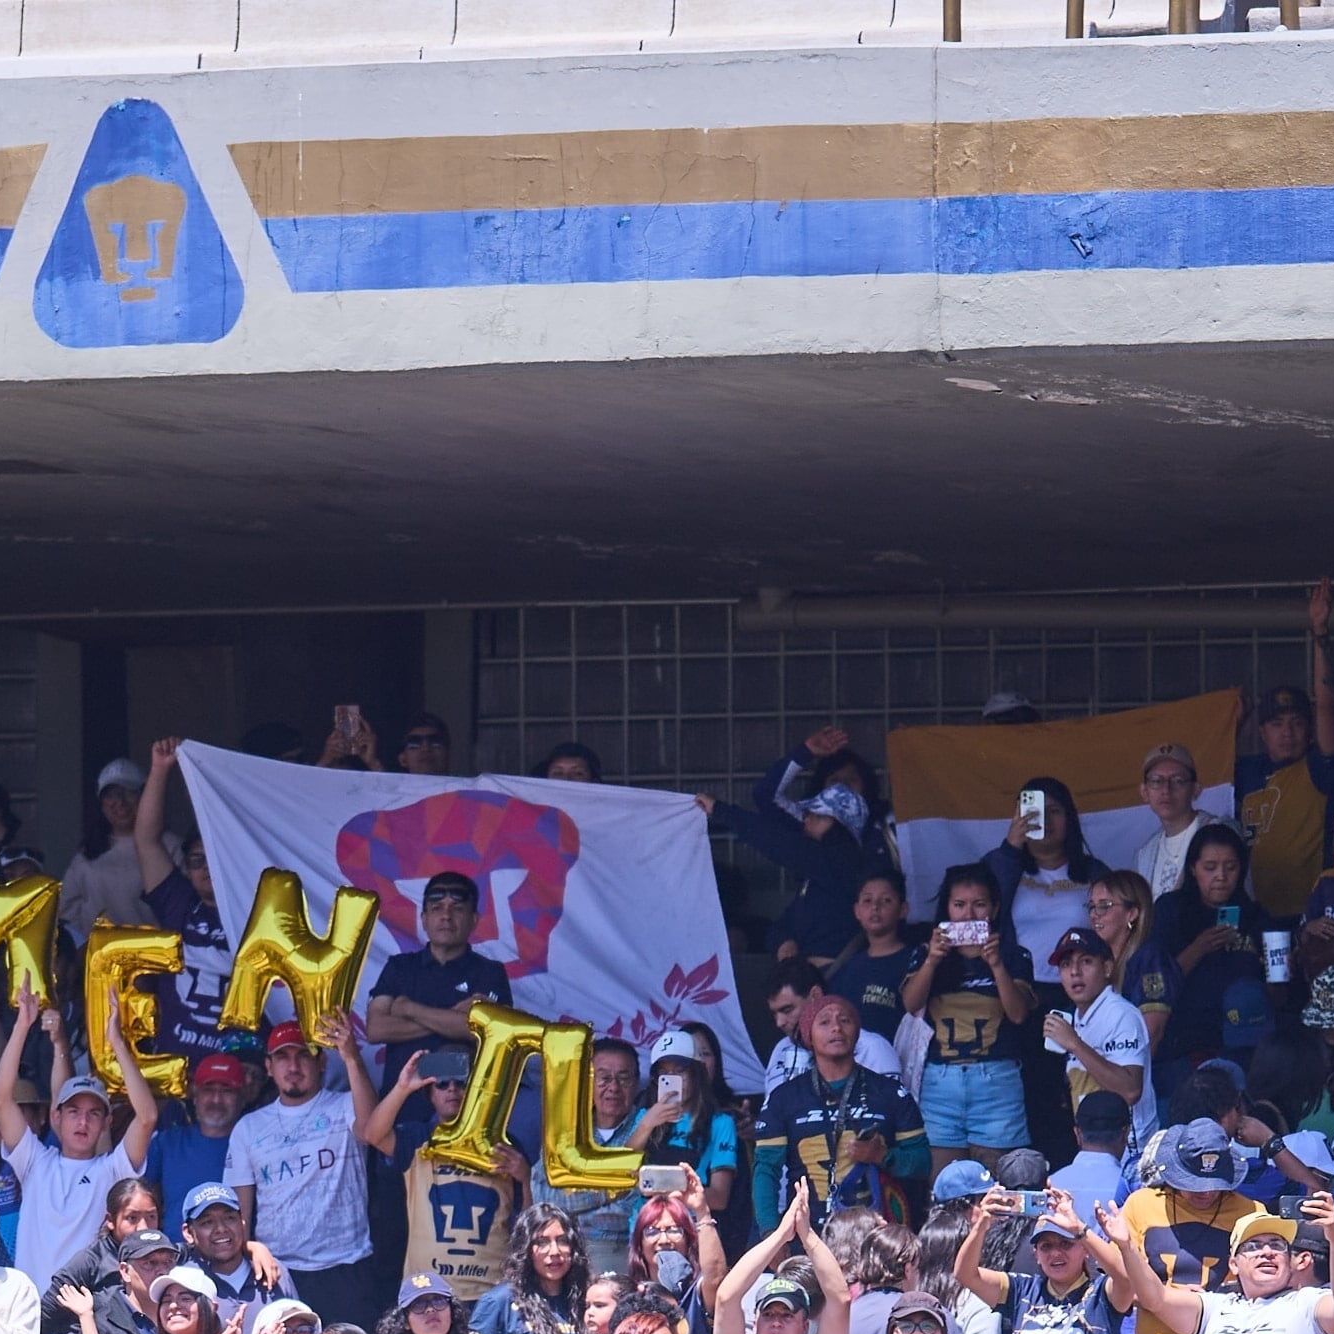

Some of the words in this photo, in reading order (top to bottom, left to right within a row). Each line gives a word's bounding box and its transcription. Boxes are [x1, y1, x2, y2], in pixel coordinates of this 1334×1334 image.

[1105, 1039, 1139, 1052] Mobil
[259, 1148, 336, 1185] KAFD
[456, 1263, 489, 1278] Mifel
